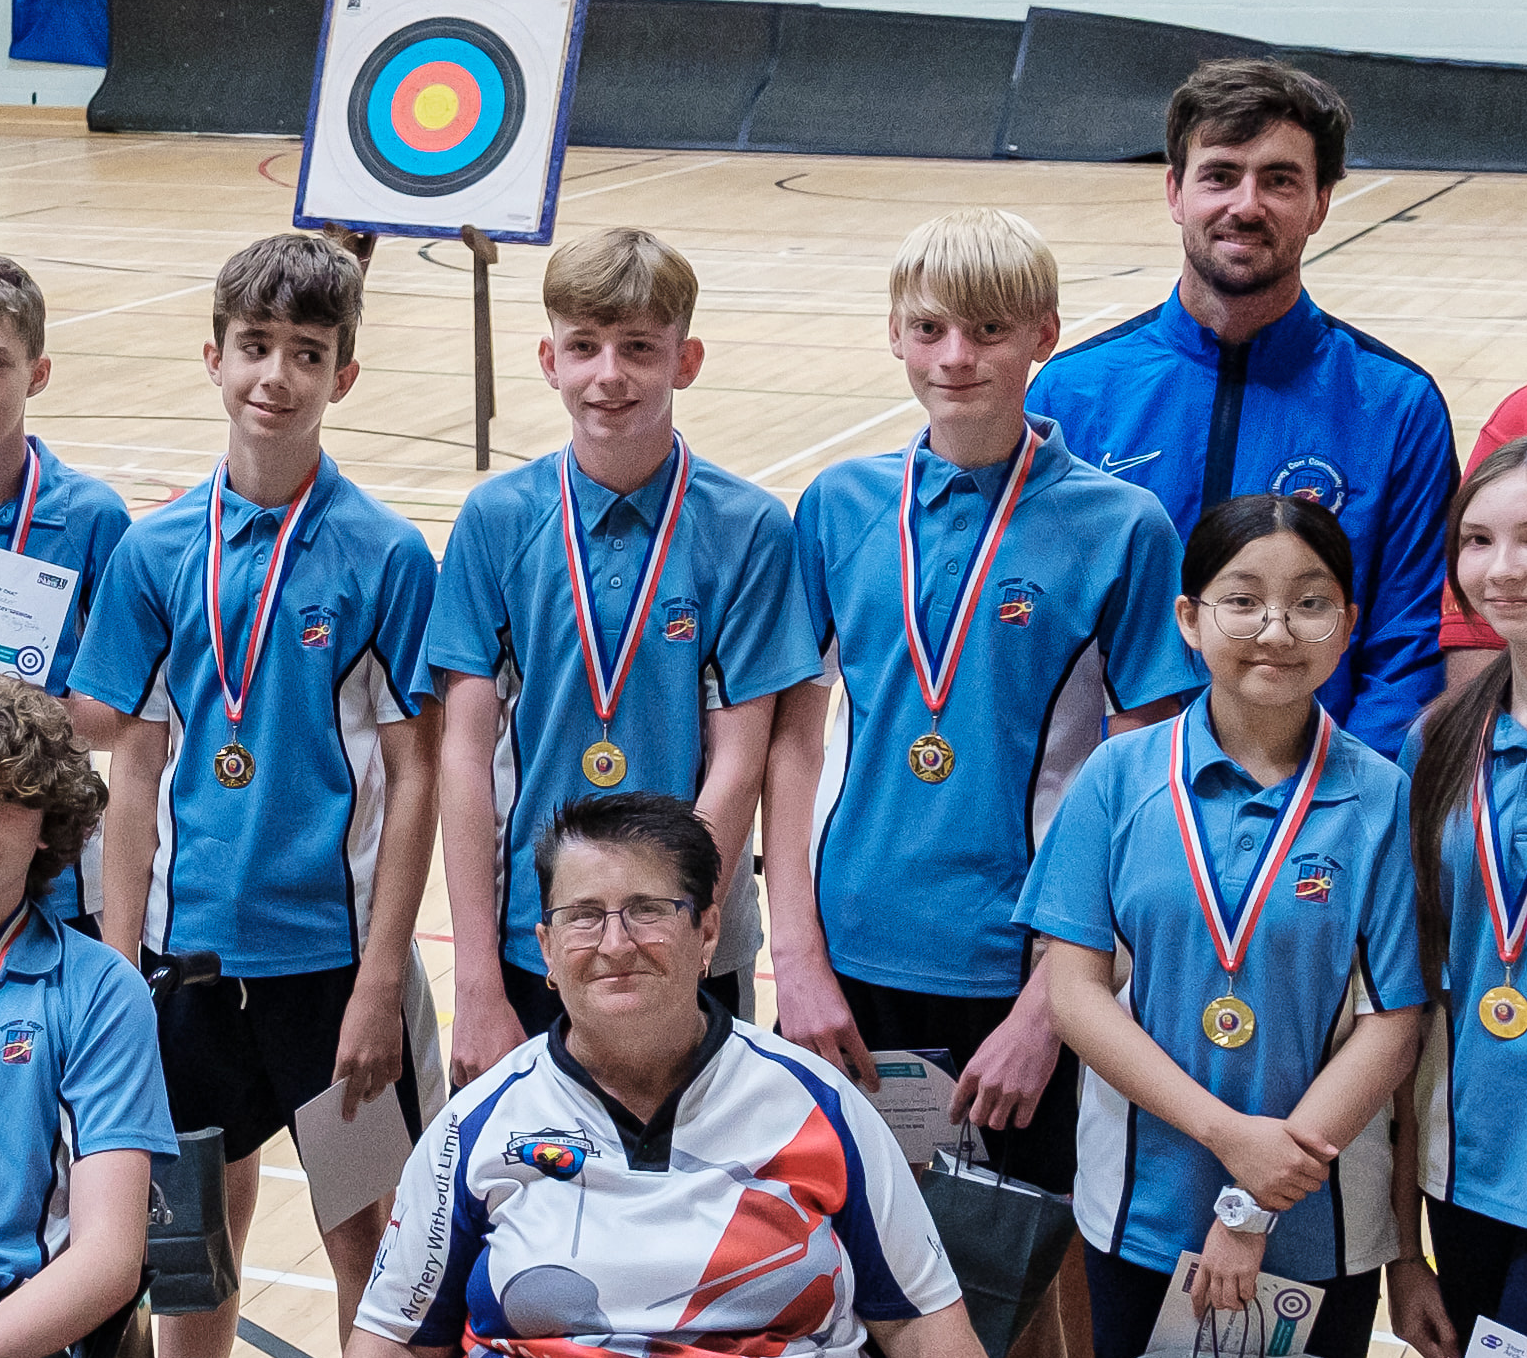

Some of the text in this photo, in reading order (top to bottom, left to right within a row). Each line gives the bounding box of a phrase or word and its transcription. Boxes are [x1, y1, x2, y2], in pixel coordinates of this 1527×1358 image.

[399, 1111, 461, 1322] Archery Without Limits
